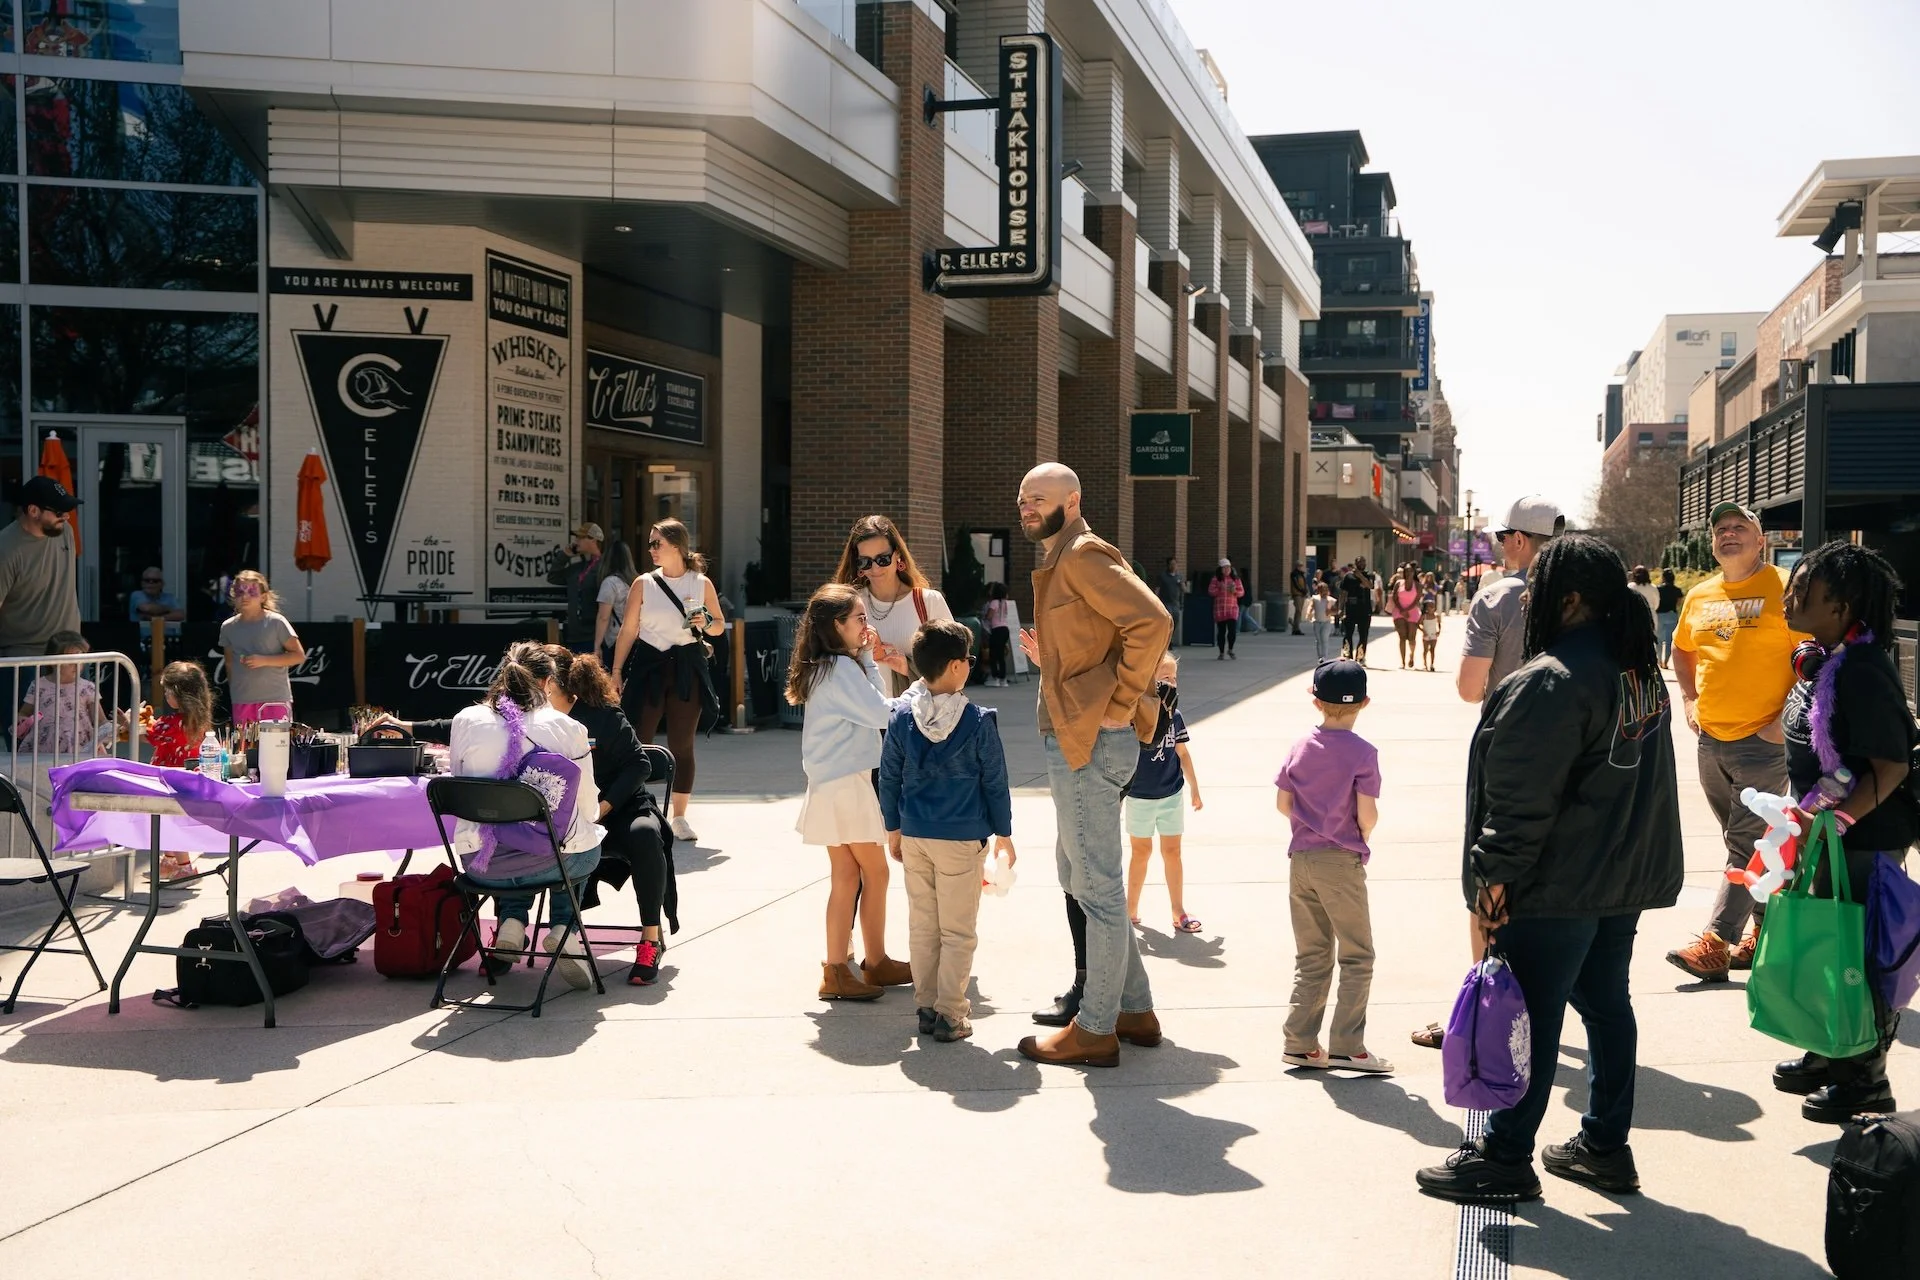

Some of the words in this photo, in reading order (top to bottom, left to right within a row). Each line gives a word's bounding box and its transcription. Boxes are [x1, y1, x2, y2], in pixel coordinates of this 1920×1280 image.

[1007, 51, 1029, 247] STEAKHOUSE
[960, 251, 1026, 269] ELLET'S
[284, 275, 309, 287] YOU
[314, 277, 338, 288] ARE
[343, 278, 394, 290] ALWAYS
[399, 280, 460, 292] WELCOME
[493, 297, 513, 314] YOU
[514, 303, 543, 322] CAN'T
[543, 310, 566, 328] LOSE
[491, 335, 567, 378] WHISKEY
[497, 405, 525, 428] PRIME
[528, 410, 561, 433] STEAKS
[505, 430, 561, 457] SANDWICHES
[364, 428, 378, 544] ELLET'S
[505, 473, 555, 490] ON-THE-GO
[498, 489, 525, 503] FRIES
[534, 493, 560, 507] BITES
[423, 536, 439, 546] the
[407, 550, 455, 575] PRIDE
[418, 579, 429, 590] of
[429, 578, 445, 590] the
[544, 791, 561, 805] PARK
